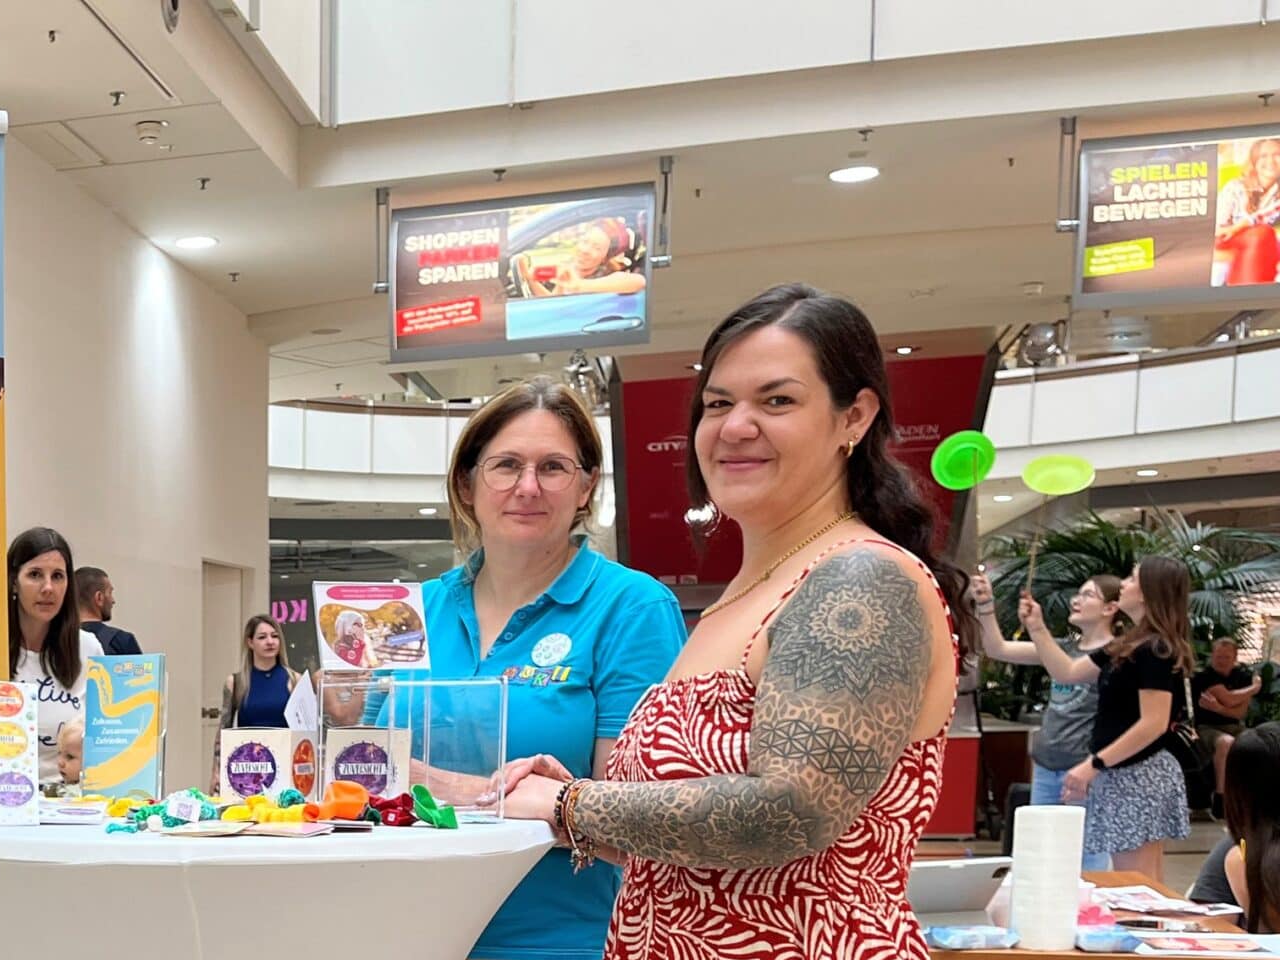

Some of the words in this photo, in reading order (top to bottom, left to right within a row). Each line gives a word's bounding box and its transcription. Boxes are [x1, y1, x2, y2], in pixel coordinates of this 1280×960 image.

[1111, 161, 1208, 184] SPIELEN
[1113, 179, 1208, 202] LACHEN
[1093, 198, 1208, 223] BEWEGEN
[404, 227, 500, 253] SHOPPEN
[418, 261, 500, 286] SPAREN
